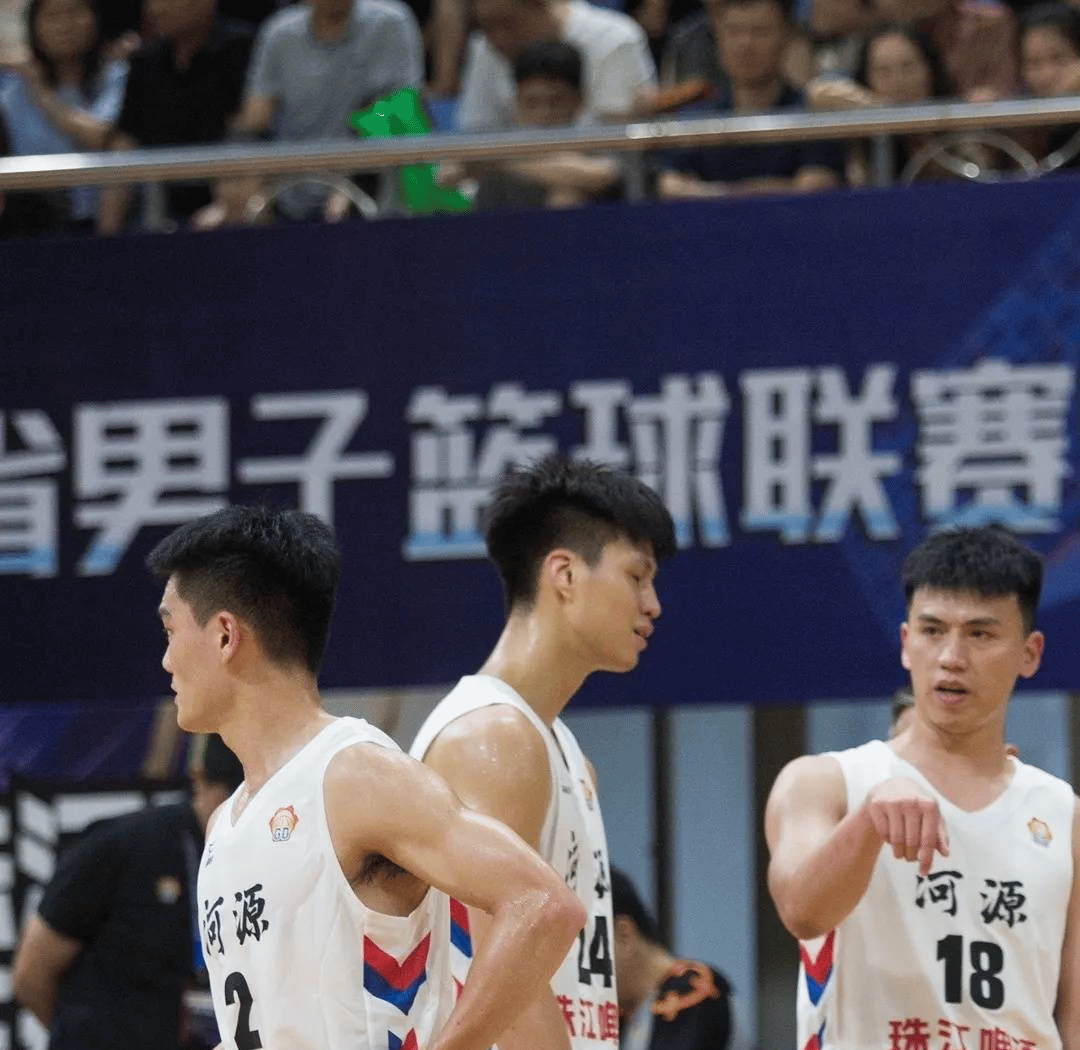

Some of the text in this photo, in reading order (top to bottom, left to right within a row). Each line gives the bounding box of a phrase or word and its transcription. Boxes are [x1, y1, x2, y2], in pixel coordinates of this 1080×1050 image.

[202, 883, 270, 956] 河源
[914, 870, 1028, 928] 河源
[936, 934, 1005, 1010] 18
